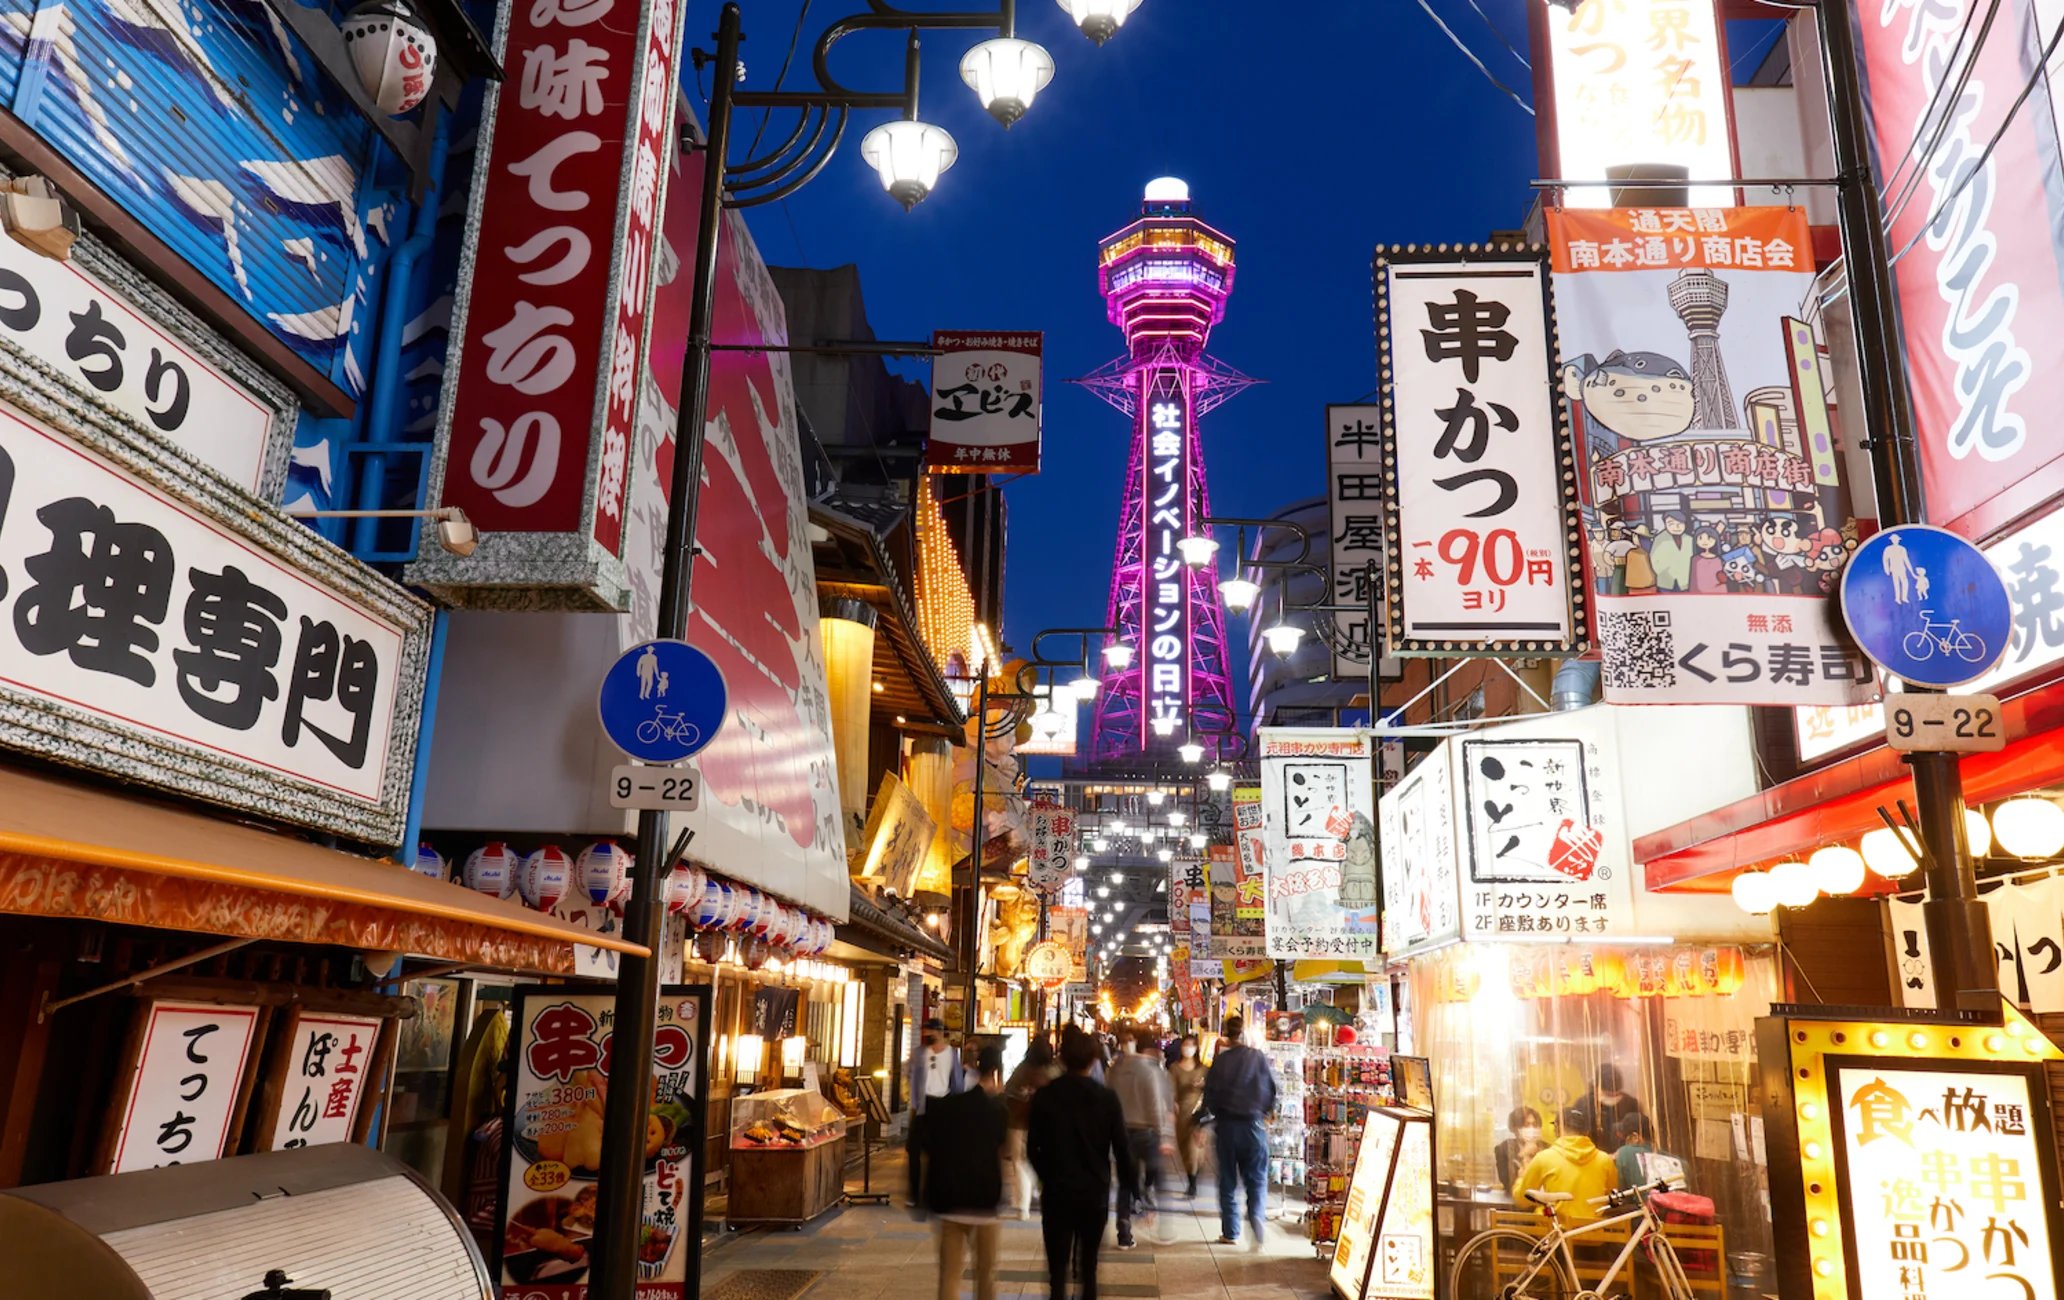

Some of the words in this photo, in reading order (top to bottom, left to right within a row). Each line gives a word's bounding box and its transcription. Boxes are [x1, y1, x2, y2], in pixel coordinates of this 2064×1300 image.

[1645, 0, 1707, 147] 界名物
[1628, 208, 1727, 234] 通天閣
[1569, 234, 1795, 270] 南本通り商店会
[1419, 289, 1519, 519] 串かつ
[954, 447, 1012, 461] 年中無休
[1599, 443, 1812, 488] 南本通り商店街
[1152, 403, 1182, 732] 社会イノベーションの日立
[1437, 528, 1525, 586] 90
[1527, 559, 1554, 587] 円
[0, 440, 378, 770] 理専門
[1462, 588, 1506, 613] ヨリ
[1746, 613, 1793, 633] 無添
[1678, 641, 1874, 687] くら寿司
[1050, 813, 1072, 871] 串かつ
[1475, 893, 1491, 908] 1F
[1498, 892, 1607, 910] カウンター席
[1475, 915, 1493, 931] 2F
[1499, 914, 1609, 932] 座敷あります
[1272, 936, 1373, 954] 宴会予約受付中
[526, 1001, 693, 1084] 串つ
[150, 1024, 220, 1168] てっち
[322, 1033, 362, 1119] 土産
[1849, 1076, 2026, 1149] 食べ放題
[1880, 1176, 1930, 1300] 逸品料
[1919, 1147, 1971, 1273] 串かつ
